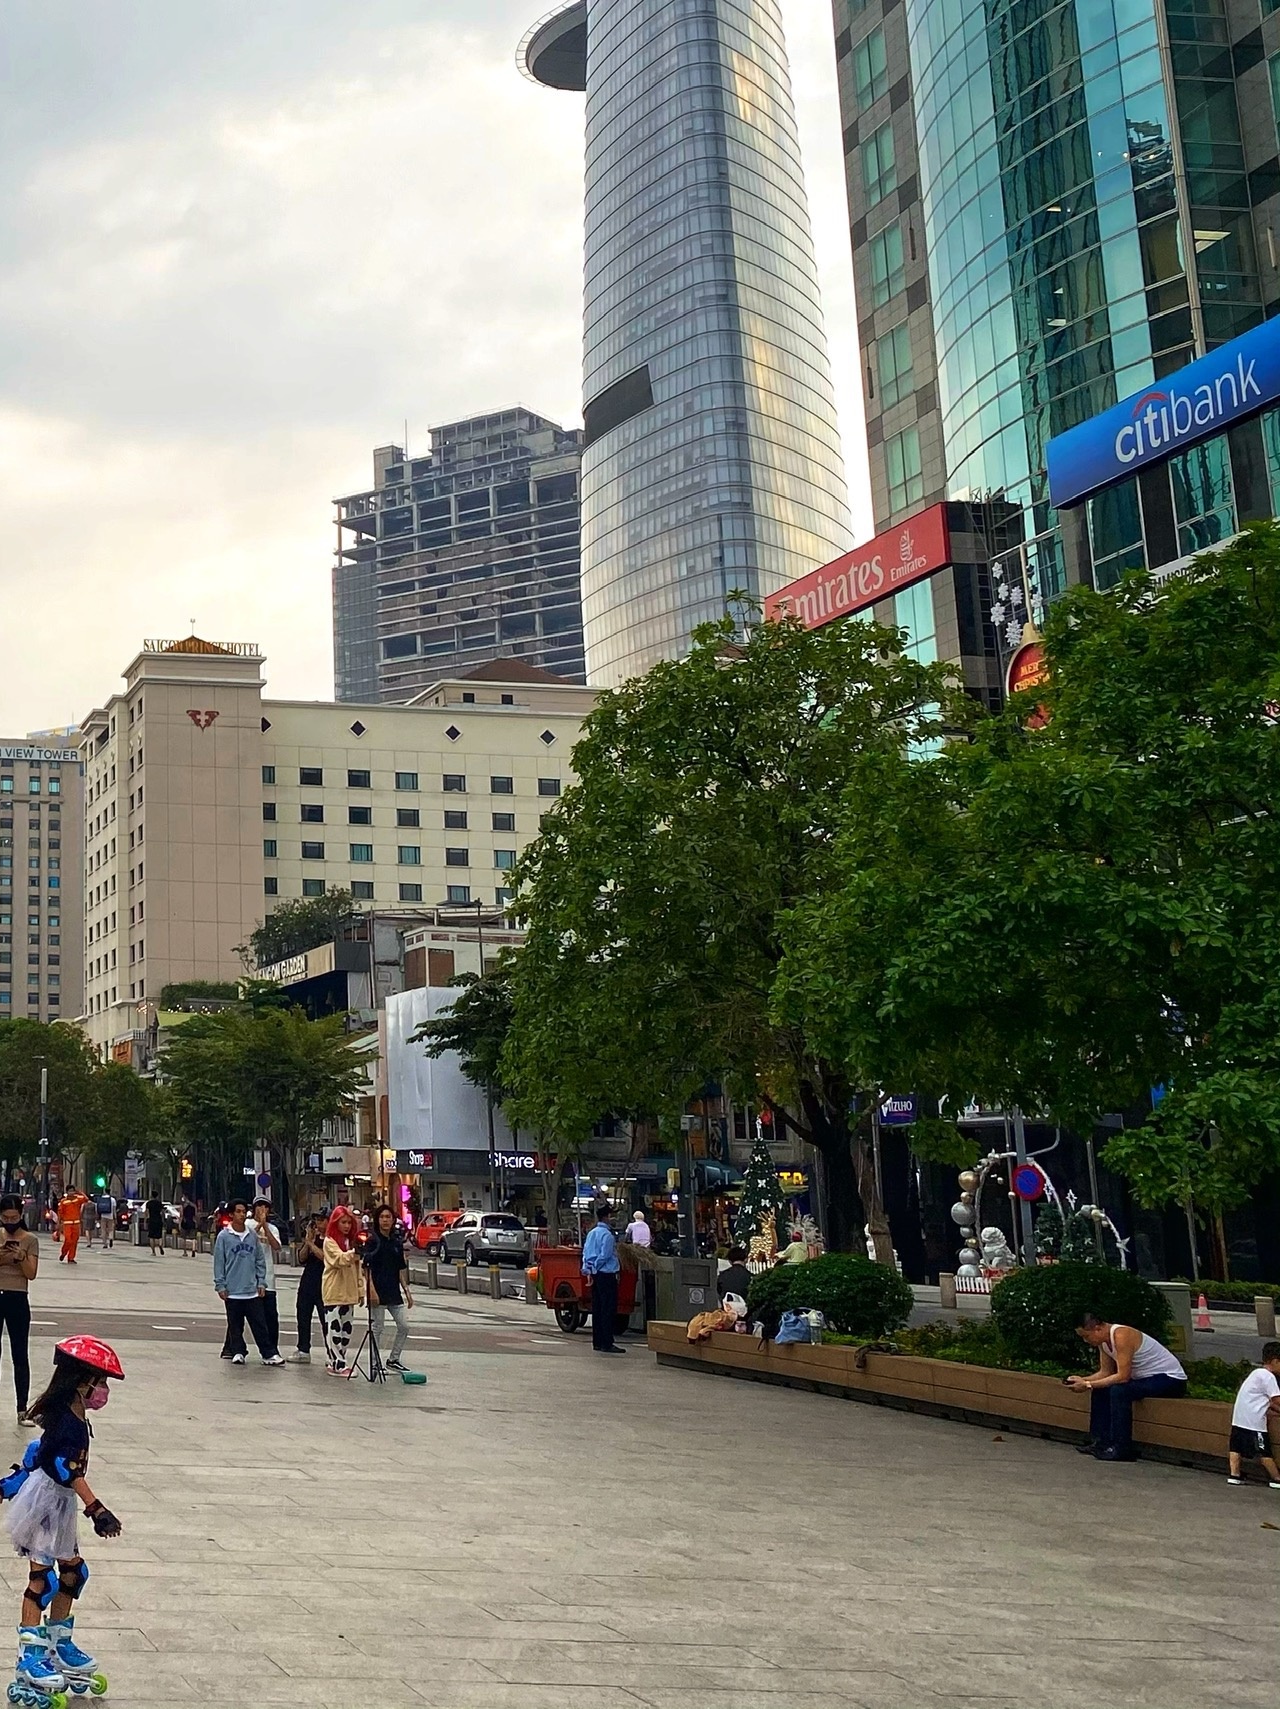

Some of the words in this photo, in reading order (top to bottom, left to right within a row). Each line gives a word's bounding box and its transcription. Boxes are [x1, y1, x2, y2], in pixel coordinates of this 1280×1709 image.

[1115, 352, 1261, 463] citibank
[890, 554, 927, 582] Emirates
[143, 639, 180, 653] SAIGON
[227, 642, 261, 656] HOTEL
[5, 748, 34, 759] VIEW
[37, 749, 78, 760] TOWER
